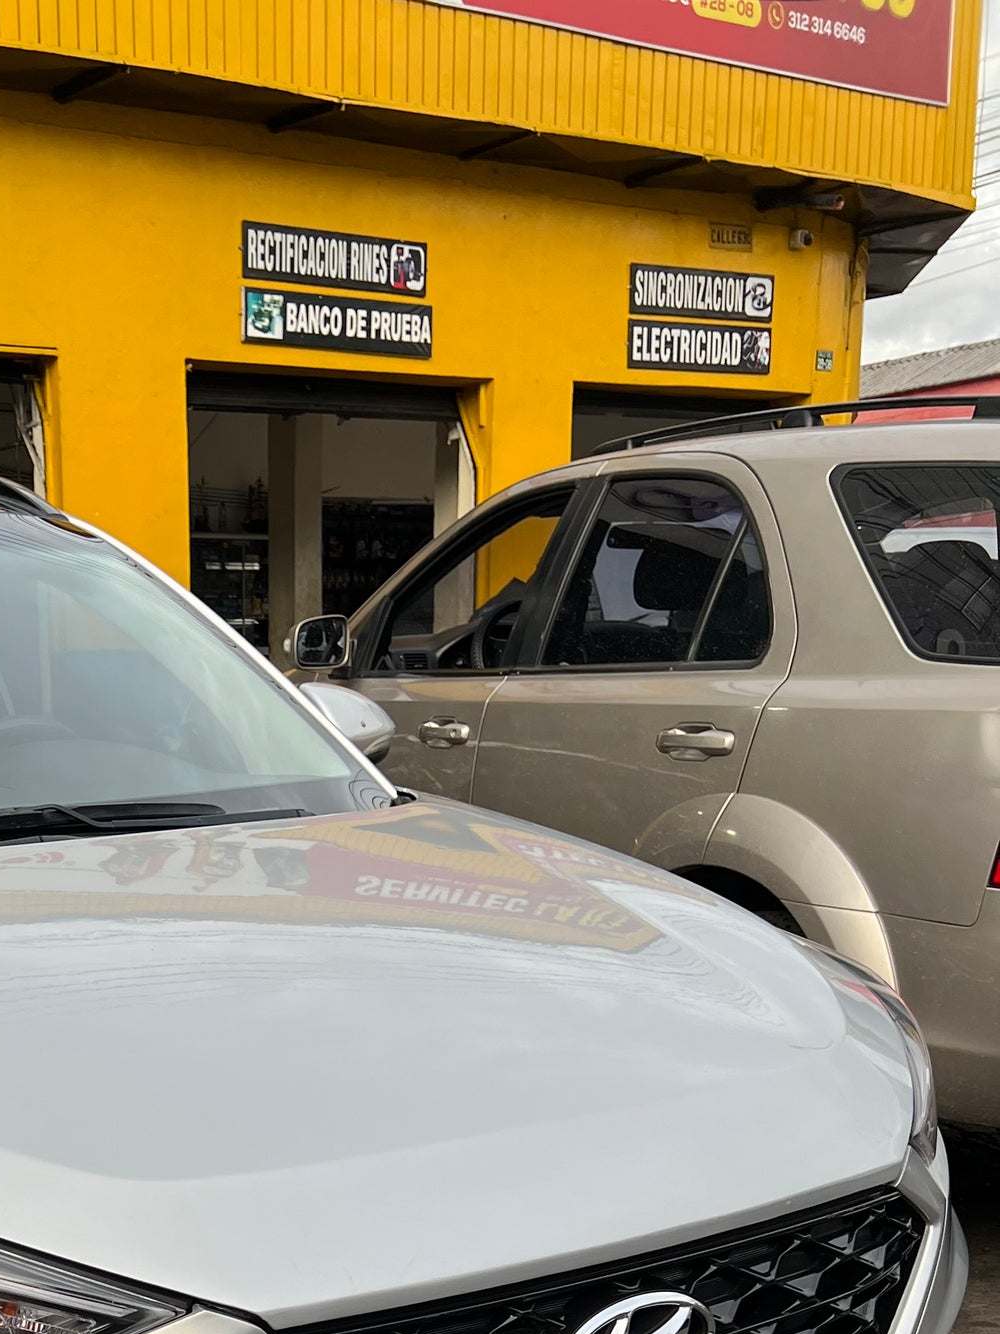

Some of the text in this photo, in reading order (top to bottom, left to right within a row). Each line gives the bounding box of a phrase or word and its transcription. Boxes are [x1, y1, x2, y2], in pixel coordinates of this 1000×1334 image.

[788, 10, 866, 45] 312 314 6646
[247, 228, 389, 285] RECTIFICACION RINES
[634, 269, 745, 313] SINCRONIZACION
[285, 302, 432, 344] BANCO DE PRUEBA
[631, 325, 742, 366] ELECTRICIDAD
